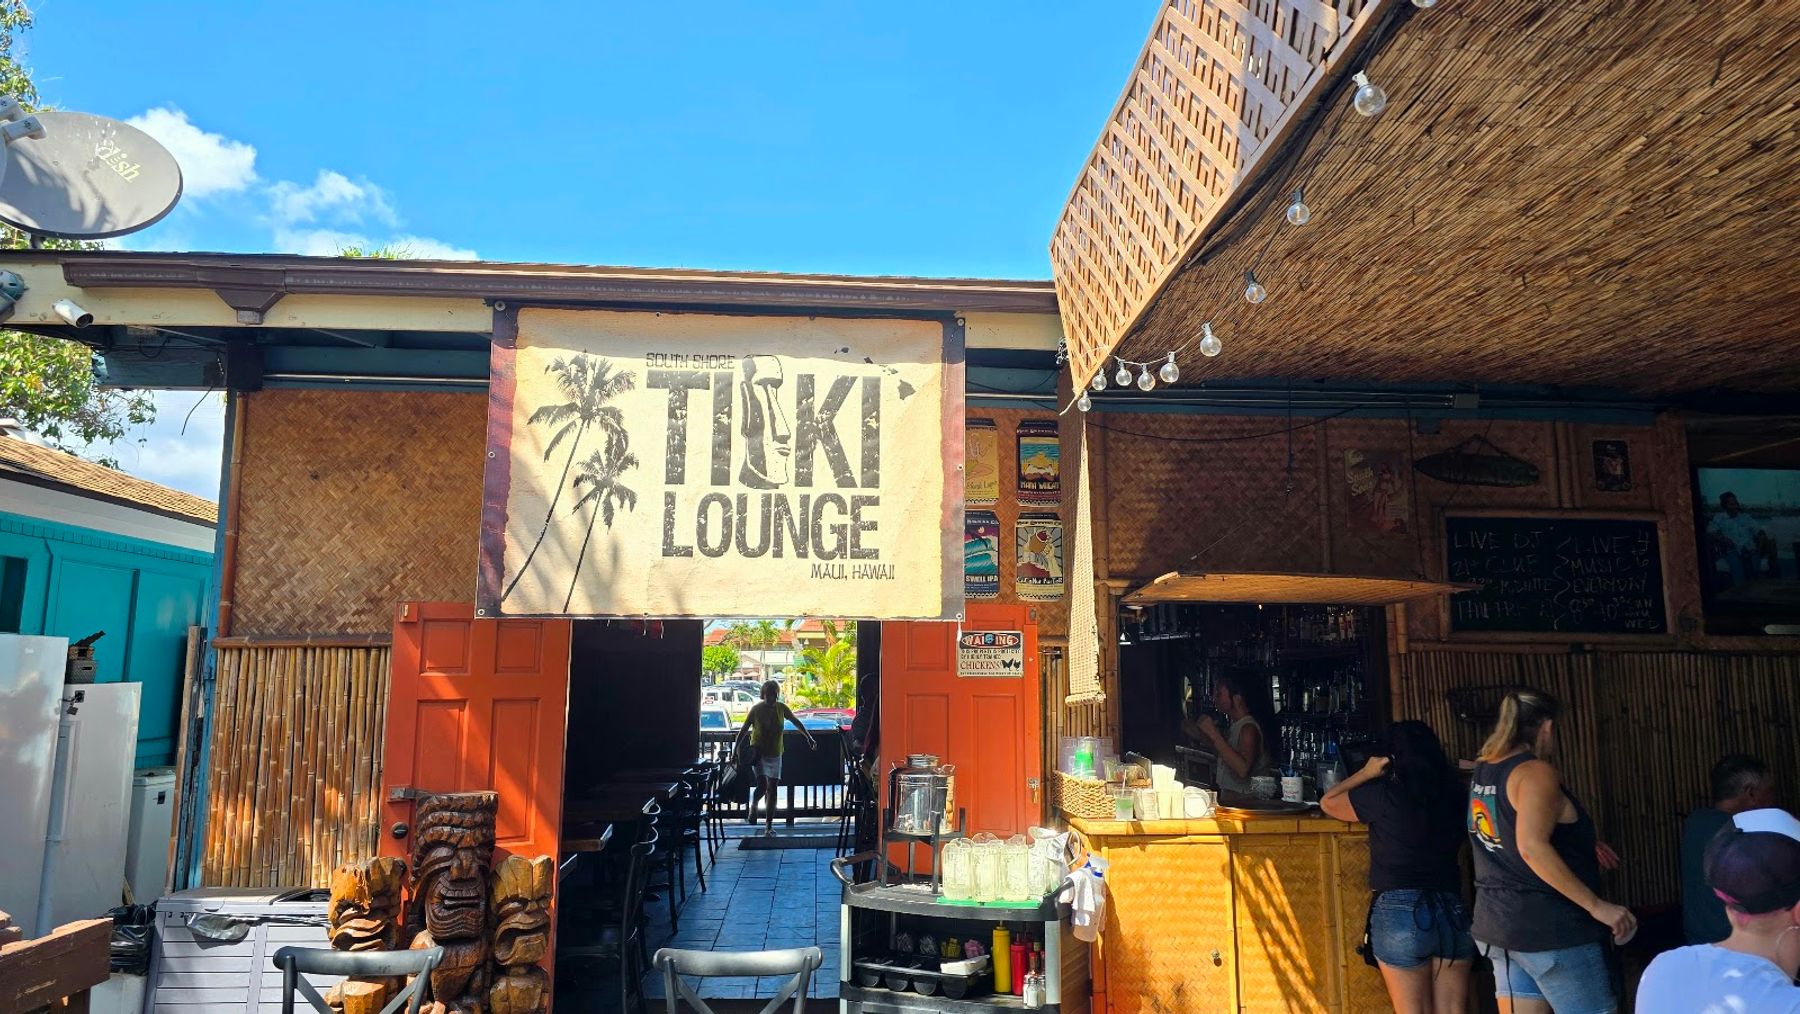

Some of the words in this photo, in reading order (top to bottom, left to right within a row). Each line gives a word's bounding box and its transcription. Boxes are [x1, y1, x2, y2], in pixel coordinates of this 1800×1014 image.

[646, 352, 690, 369] SOUTH
[693, 353, 736, 370] SHORE
[646, 370, 882, 489] TIKI
[661, 491, 881, 560] LOUNGE
[1454, 530, 1502, 549] LIVE
[1574, 535, 1630, 554] LIVE
[852, 563, 895, 580] HAWAII
[1571, 557, 1633, 576] MUSIC
